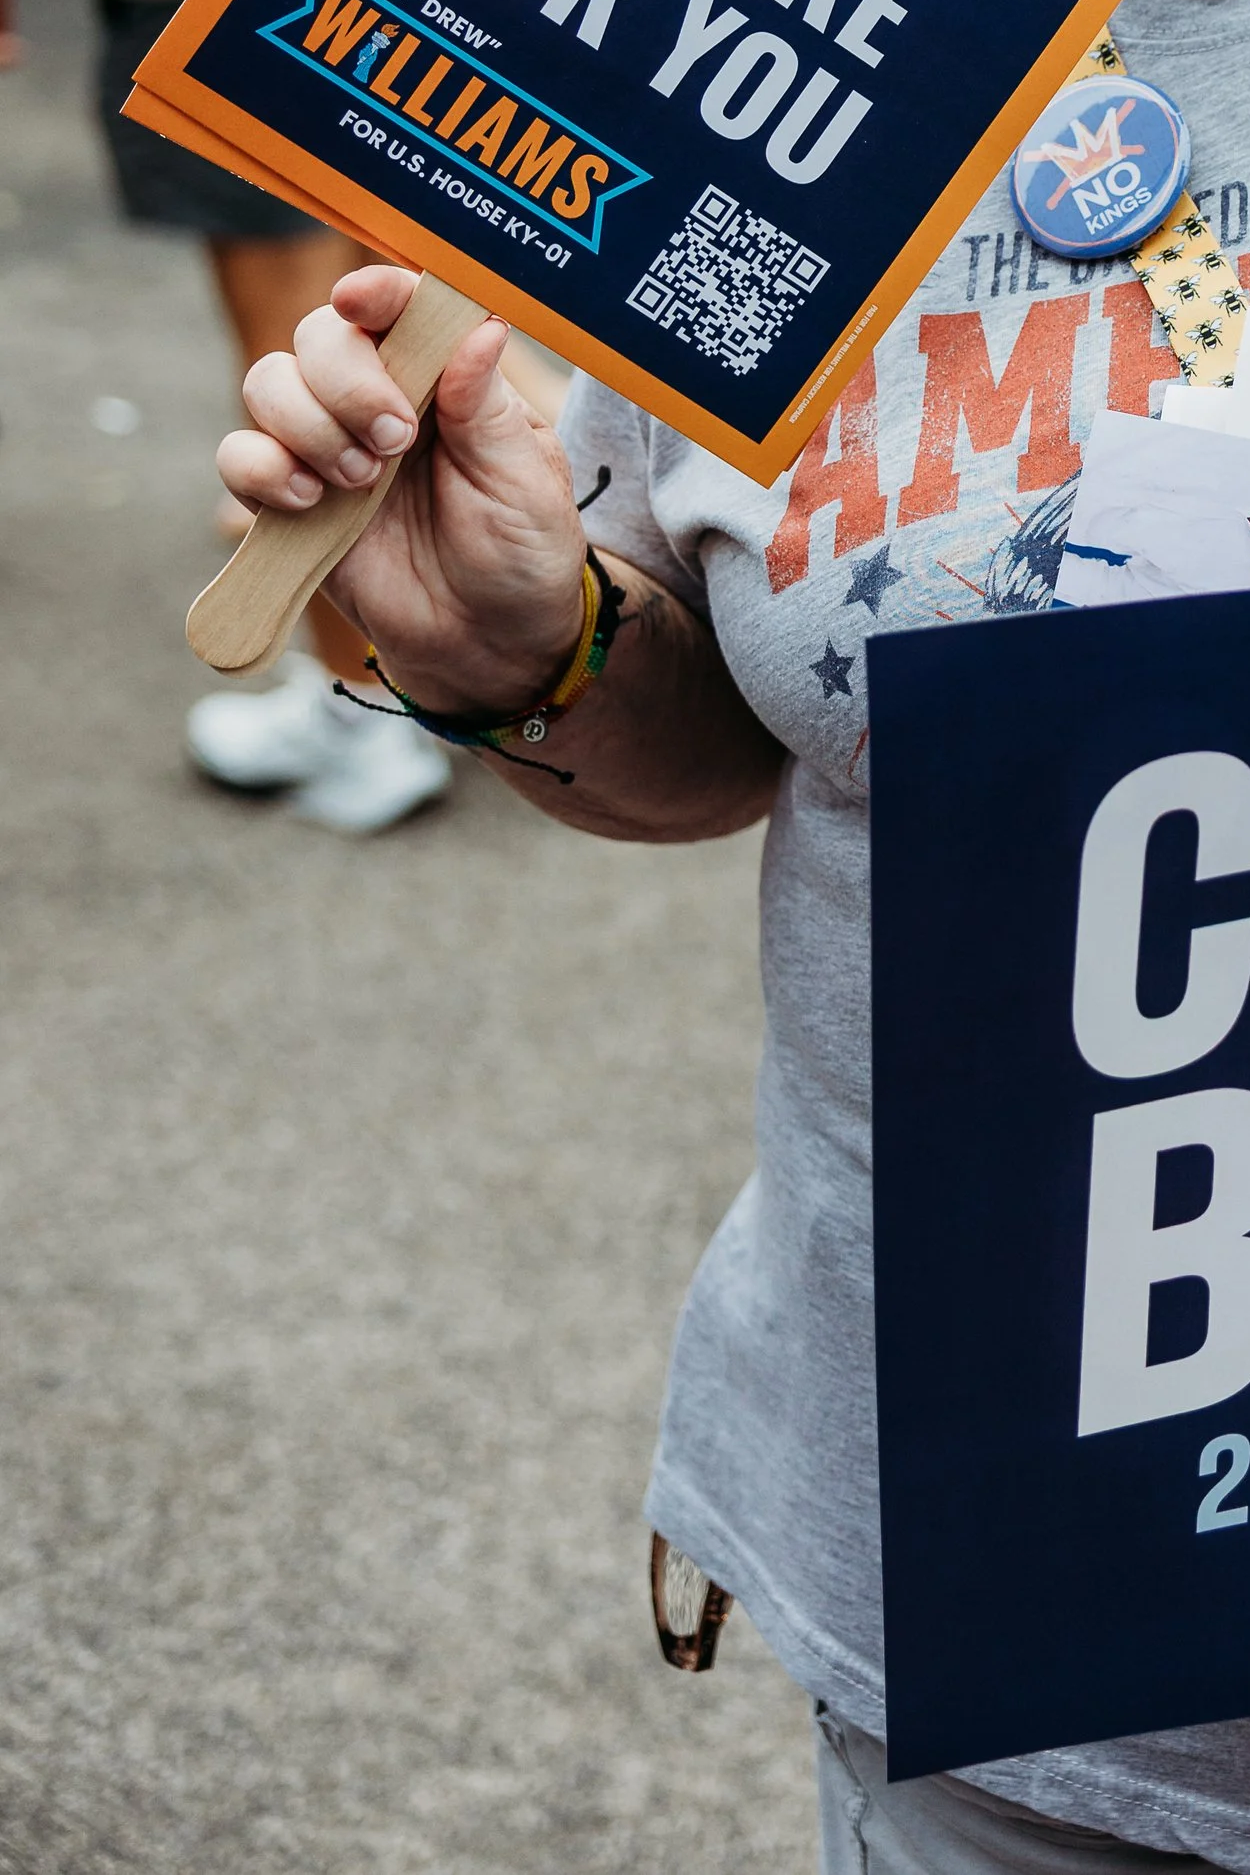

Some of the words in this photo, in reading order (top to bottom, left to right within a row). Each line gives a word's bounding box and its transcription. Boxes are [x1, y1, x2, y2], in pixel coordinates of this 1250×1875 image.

[338, 109, 388, 150] FOR
[388, 139, 426, 178] U.S.
[428, 167, 507, 227] HOUSE
[503, 215, 573, 269] KY-01
[1072, 161, 1141, 219] NO
[1085, 187, 1152, 235] KINGS
[962, 229, 1050, 302] THE
[846, 333, 856, 344] THE
[858, 315, 869, 327] FOR
[823, 364, 833, 376] FOR
